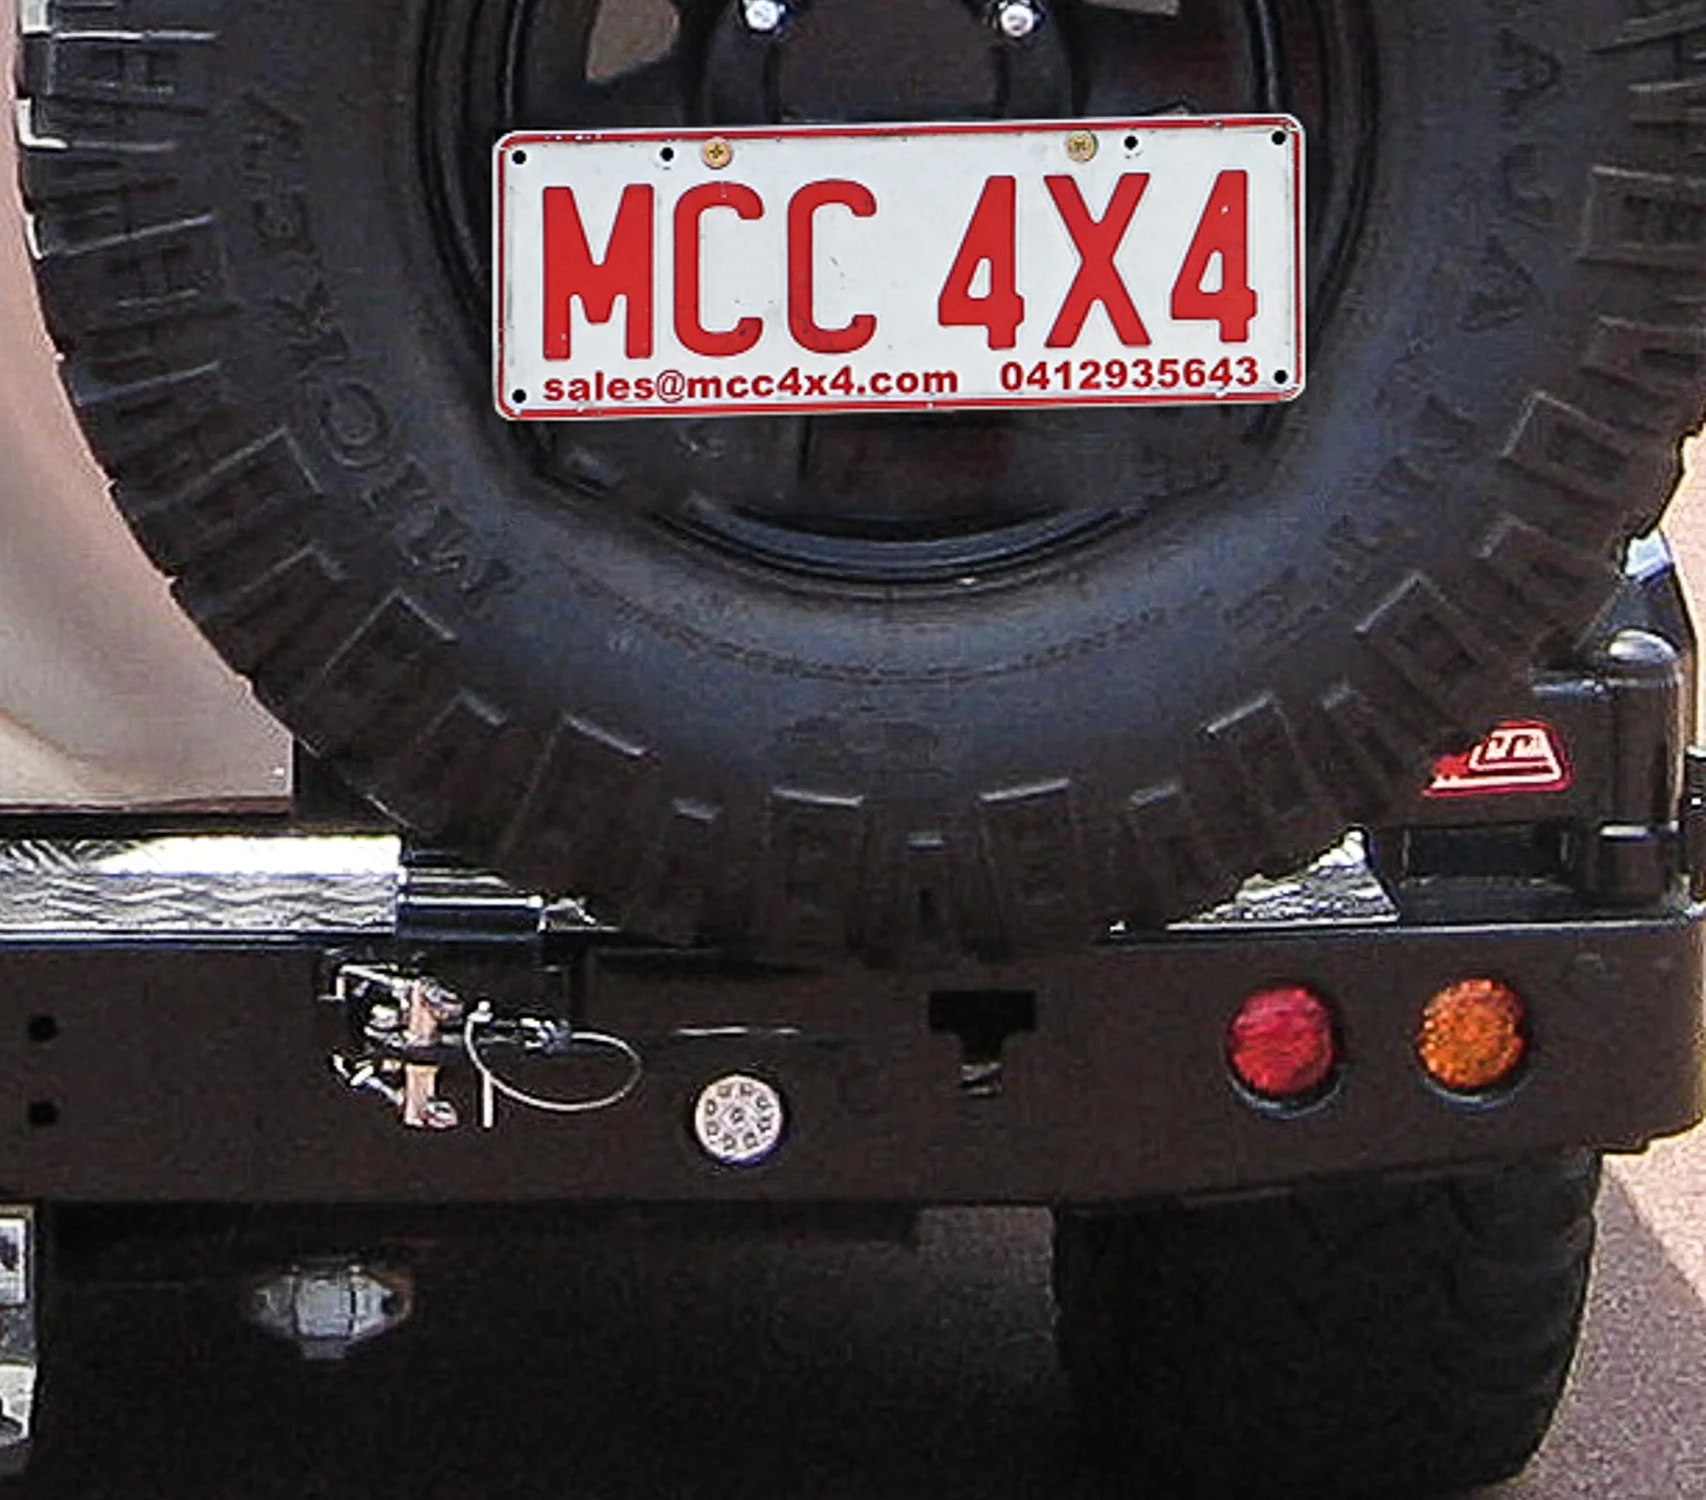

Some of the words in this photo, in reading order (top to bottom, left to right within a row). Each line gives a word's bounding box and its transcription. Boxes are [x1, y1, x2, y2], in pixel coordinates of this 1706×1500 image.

[542, 181, 878, 361] MCC
[938, 169, 1258, 350] 4X4
[542, 365, 959, 403] sales@mcc4x4.com
[1000, 356, 1260, 394] 0412935643
